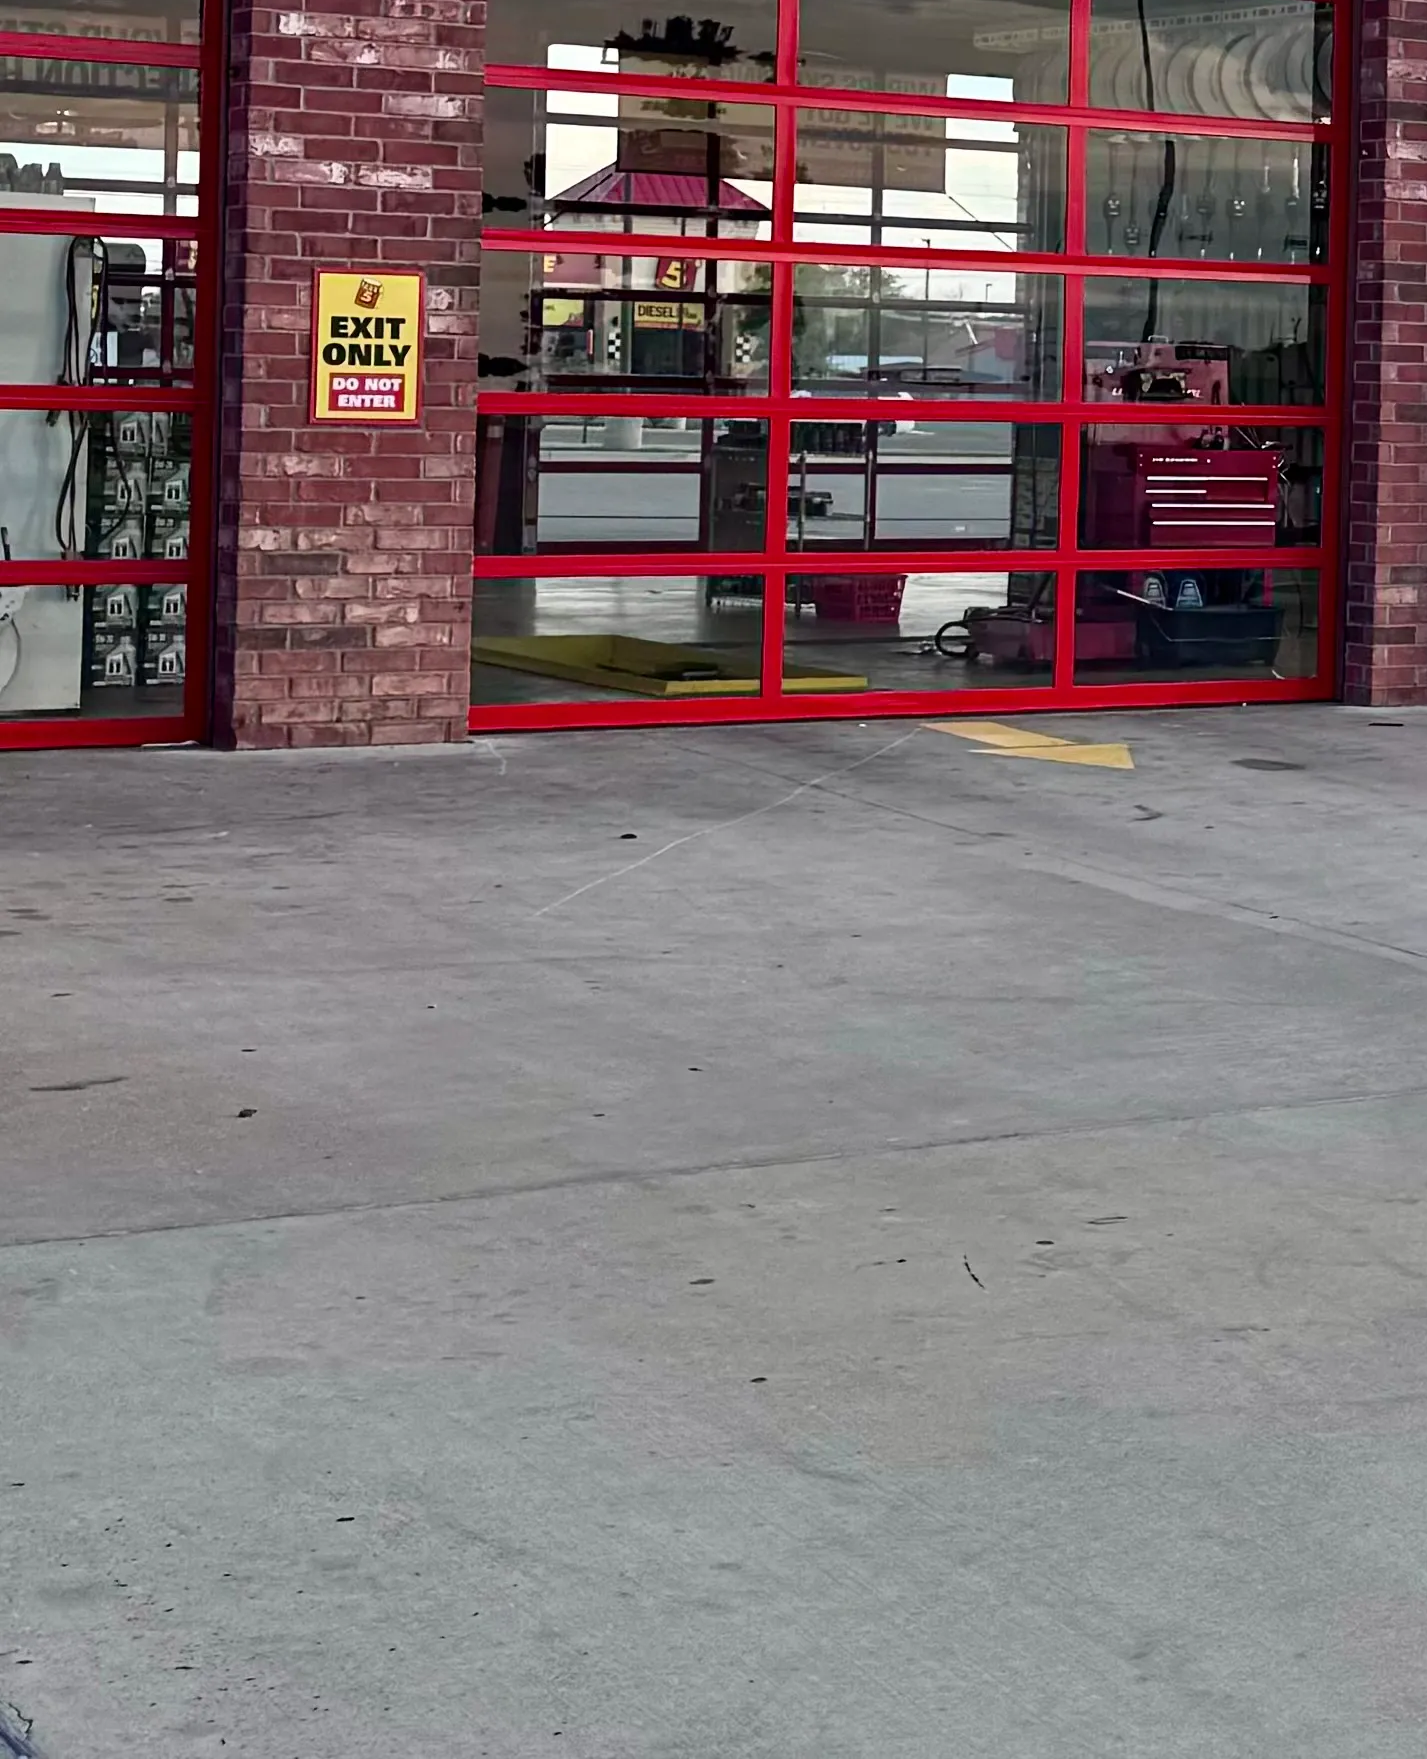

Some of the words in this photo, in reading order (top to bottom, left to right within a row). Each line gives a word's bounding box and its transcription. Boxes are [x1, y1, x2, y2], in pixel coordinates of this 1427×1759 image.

[637, 304, 677, 319] DIESEL
[331, 316, 406, 340] EXIT
[322, 343, 412, 367] ONLY
[332, 377, 359, 391] DO
[364, 378, 402, 392] NOT
[337, 394, 396, 408] ENTER
